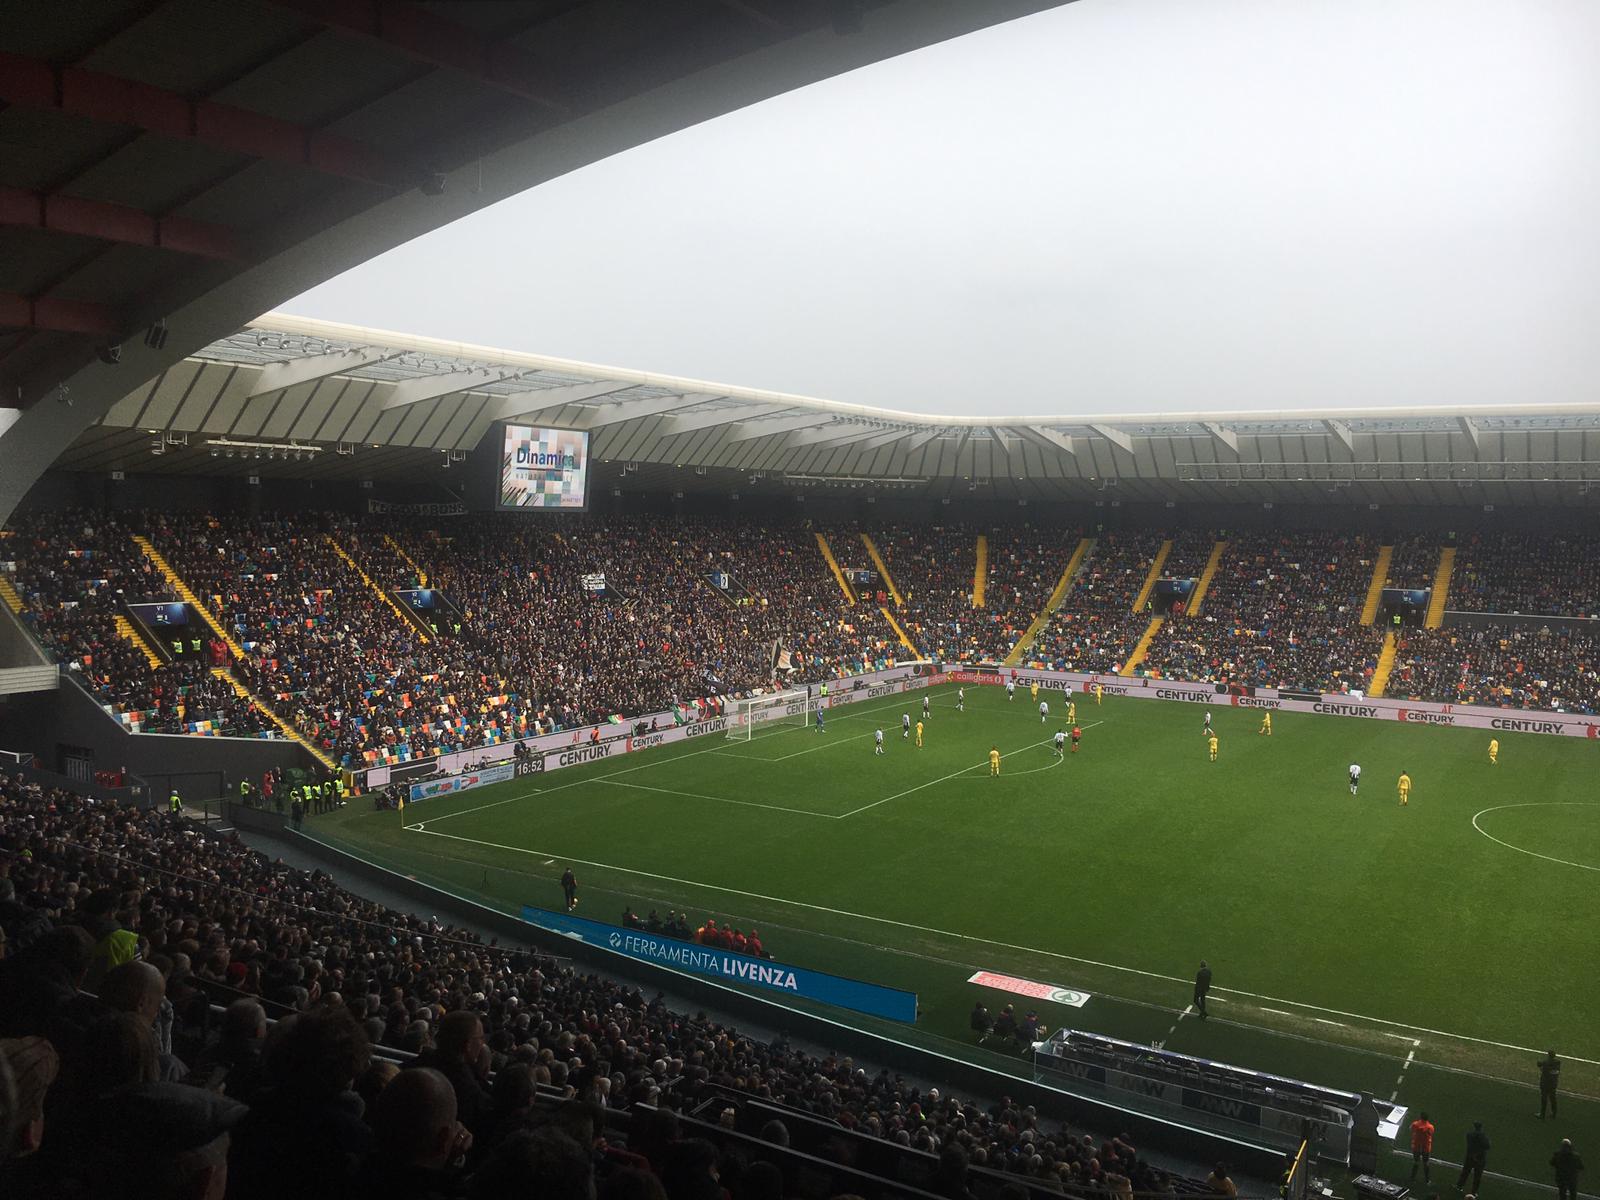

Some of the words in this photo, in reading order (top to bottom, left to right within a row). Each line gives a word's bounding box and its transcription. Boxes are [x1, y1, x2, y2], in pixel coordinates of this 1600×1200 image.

[867, 685, 896, 699] CENTURY
[1090, 685, 1128, 695] CNTURY
[1156, 689, 1214, 703] CENTURY
[1239, 698, 1281, 708] CENTURY
[1313, 703, 1377, 718] CENTURY
[1407, 712, 1455, 723] CENTURY
[686, 718, 728, 737] CENTURY
[1491, 719, 1564, 735] CENTURY
[632, 734, 664, 748] CENTURY
[559, 744, 611, 767] CENTURY
[517, 759, 543, 776] 16:52
[625, 935, 719, 972] FERRAMENTA
[723, 957, 798, 990] LIVENZA
